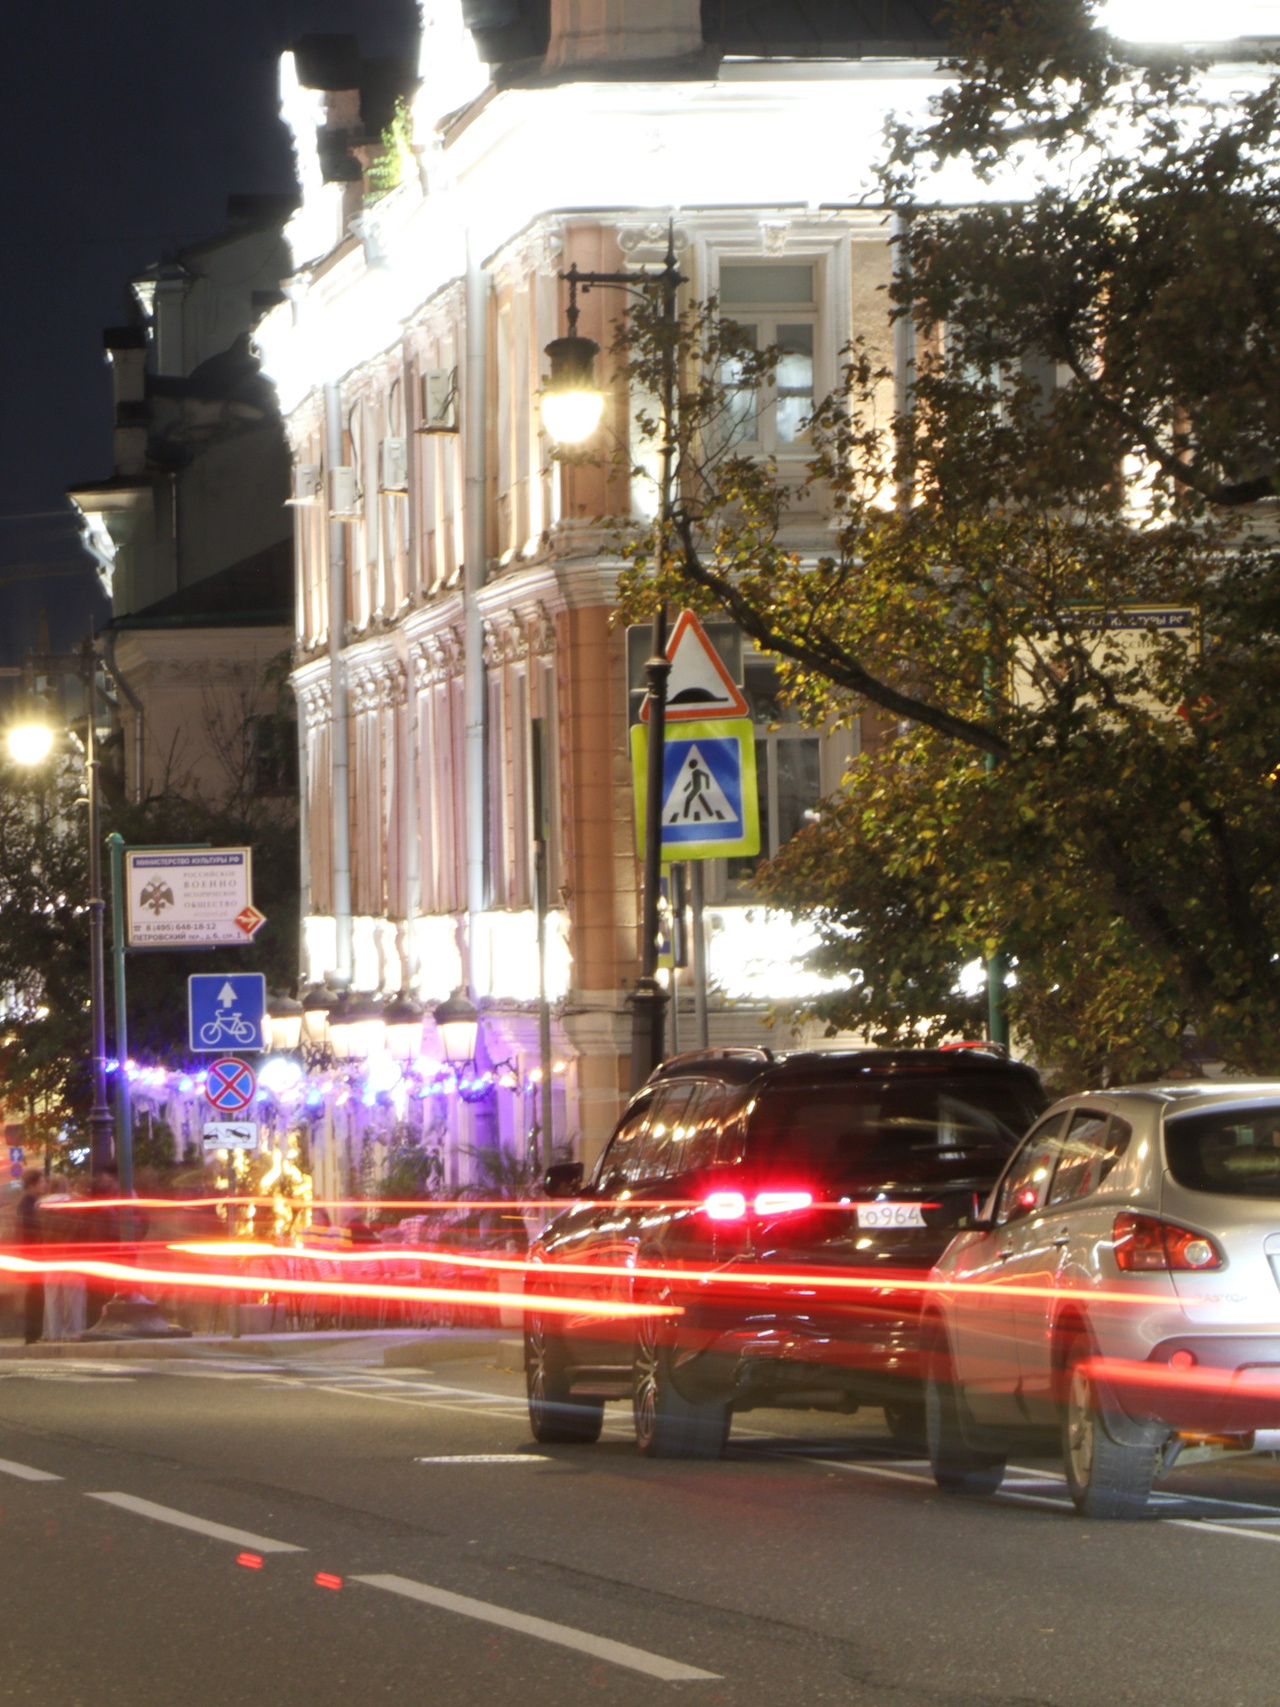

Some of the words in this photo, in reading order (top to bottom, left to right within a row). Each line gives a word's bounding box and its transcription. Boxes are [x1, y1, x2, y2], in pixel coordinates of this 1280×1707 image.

[136, 858, 190, 866] МИНИСТЕРСТВО
[183, 879, 237, 889] ВОЕННО
[183, 900, 238, 908] ОБЩЕСТВО
[152, 923, 174, 932] (495)
[175, 922, 217, 931] 648-18-12
[133, 932, 187, 942] ПЕТРОВСКИЙ
